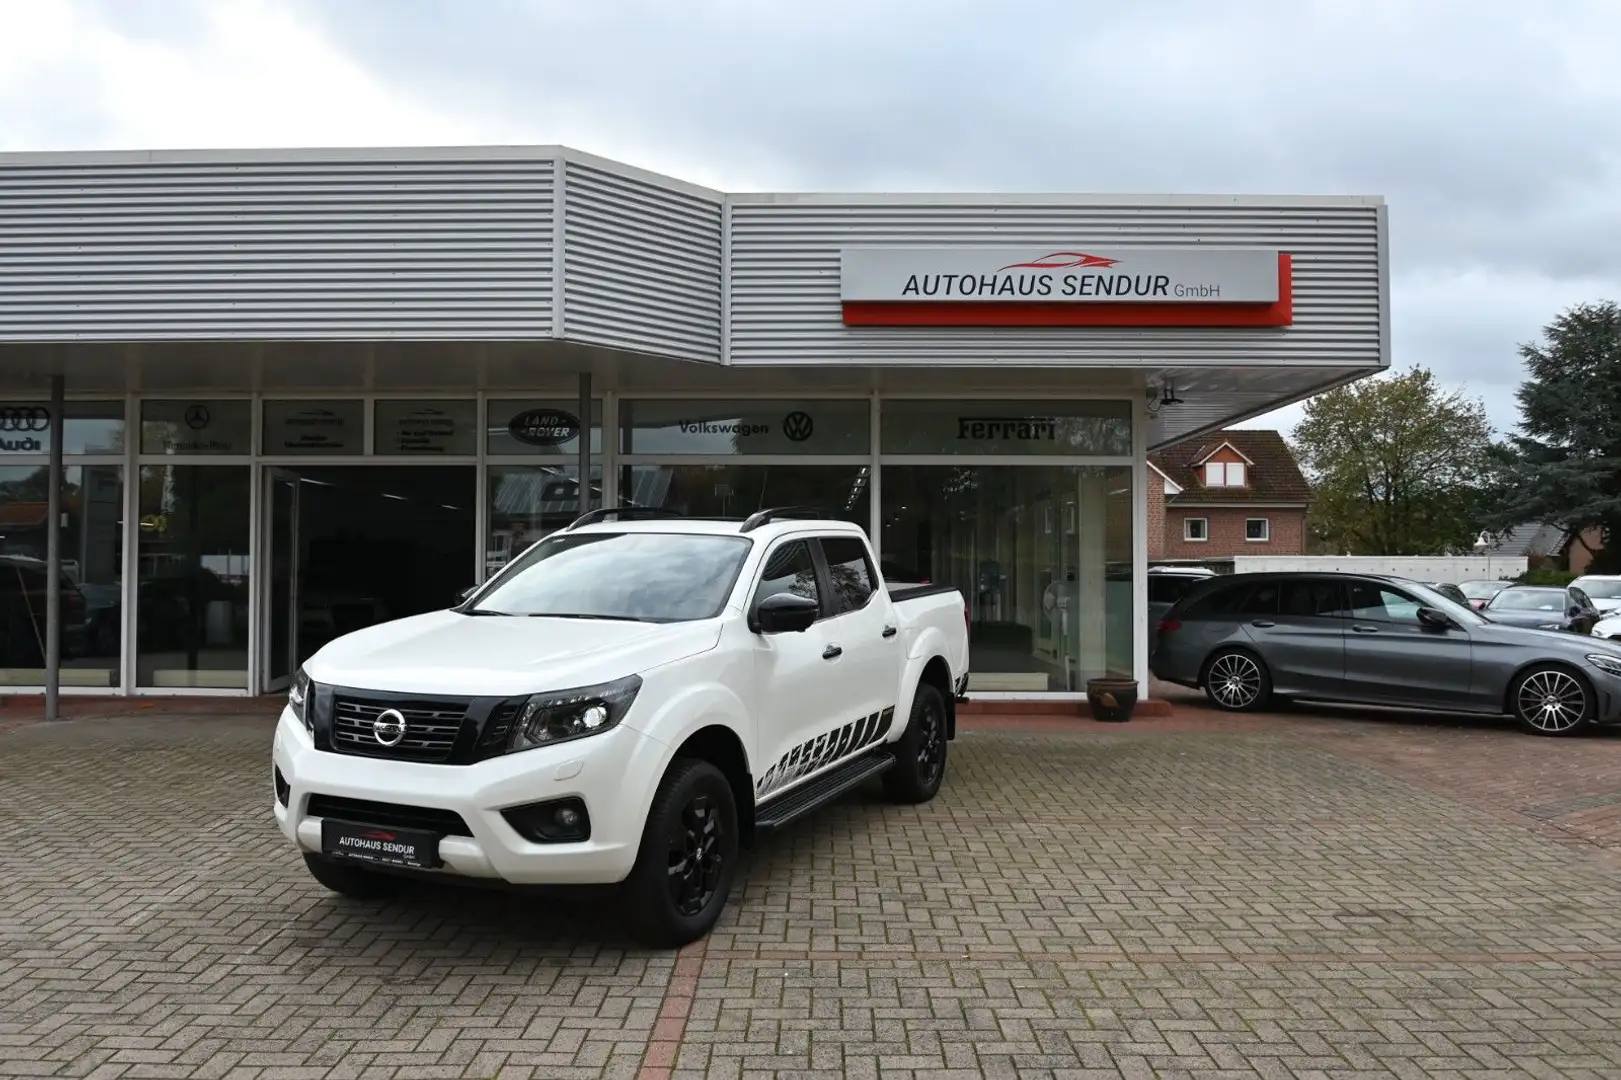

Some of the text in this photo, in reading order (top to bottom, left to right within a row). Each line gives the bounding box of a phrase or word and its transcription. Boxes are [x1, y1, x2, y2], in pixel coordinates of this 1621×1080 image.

[902, 274, 1221, 297] AUTOHAUS SENDUR GmbH
[679, 420, 769, 436] Volkswagen
[957, 418, 1056, 439] Ferrari
[339, 836, 415, 855] AUTOHAUS SENDUR
